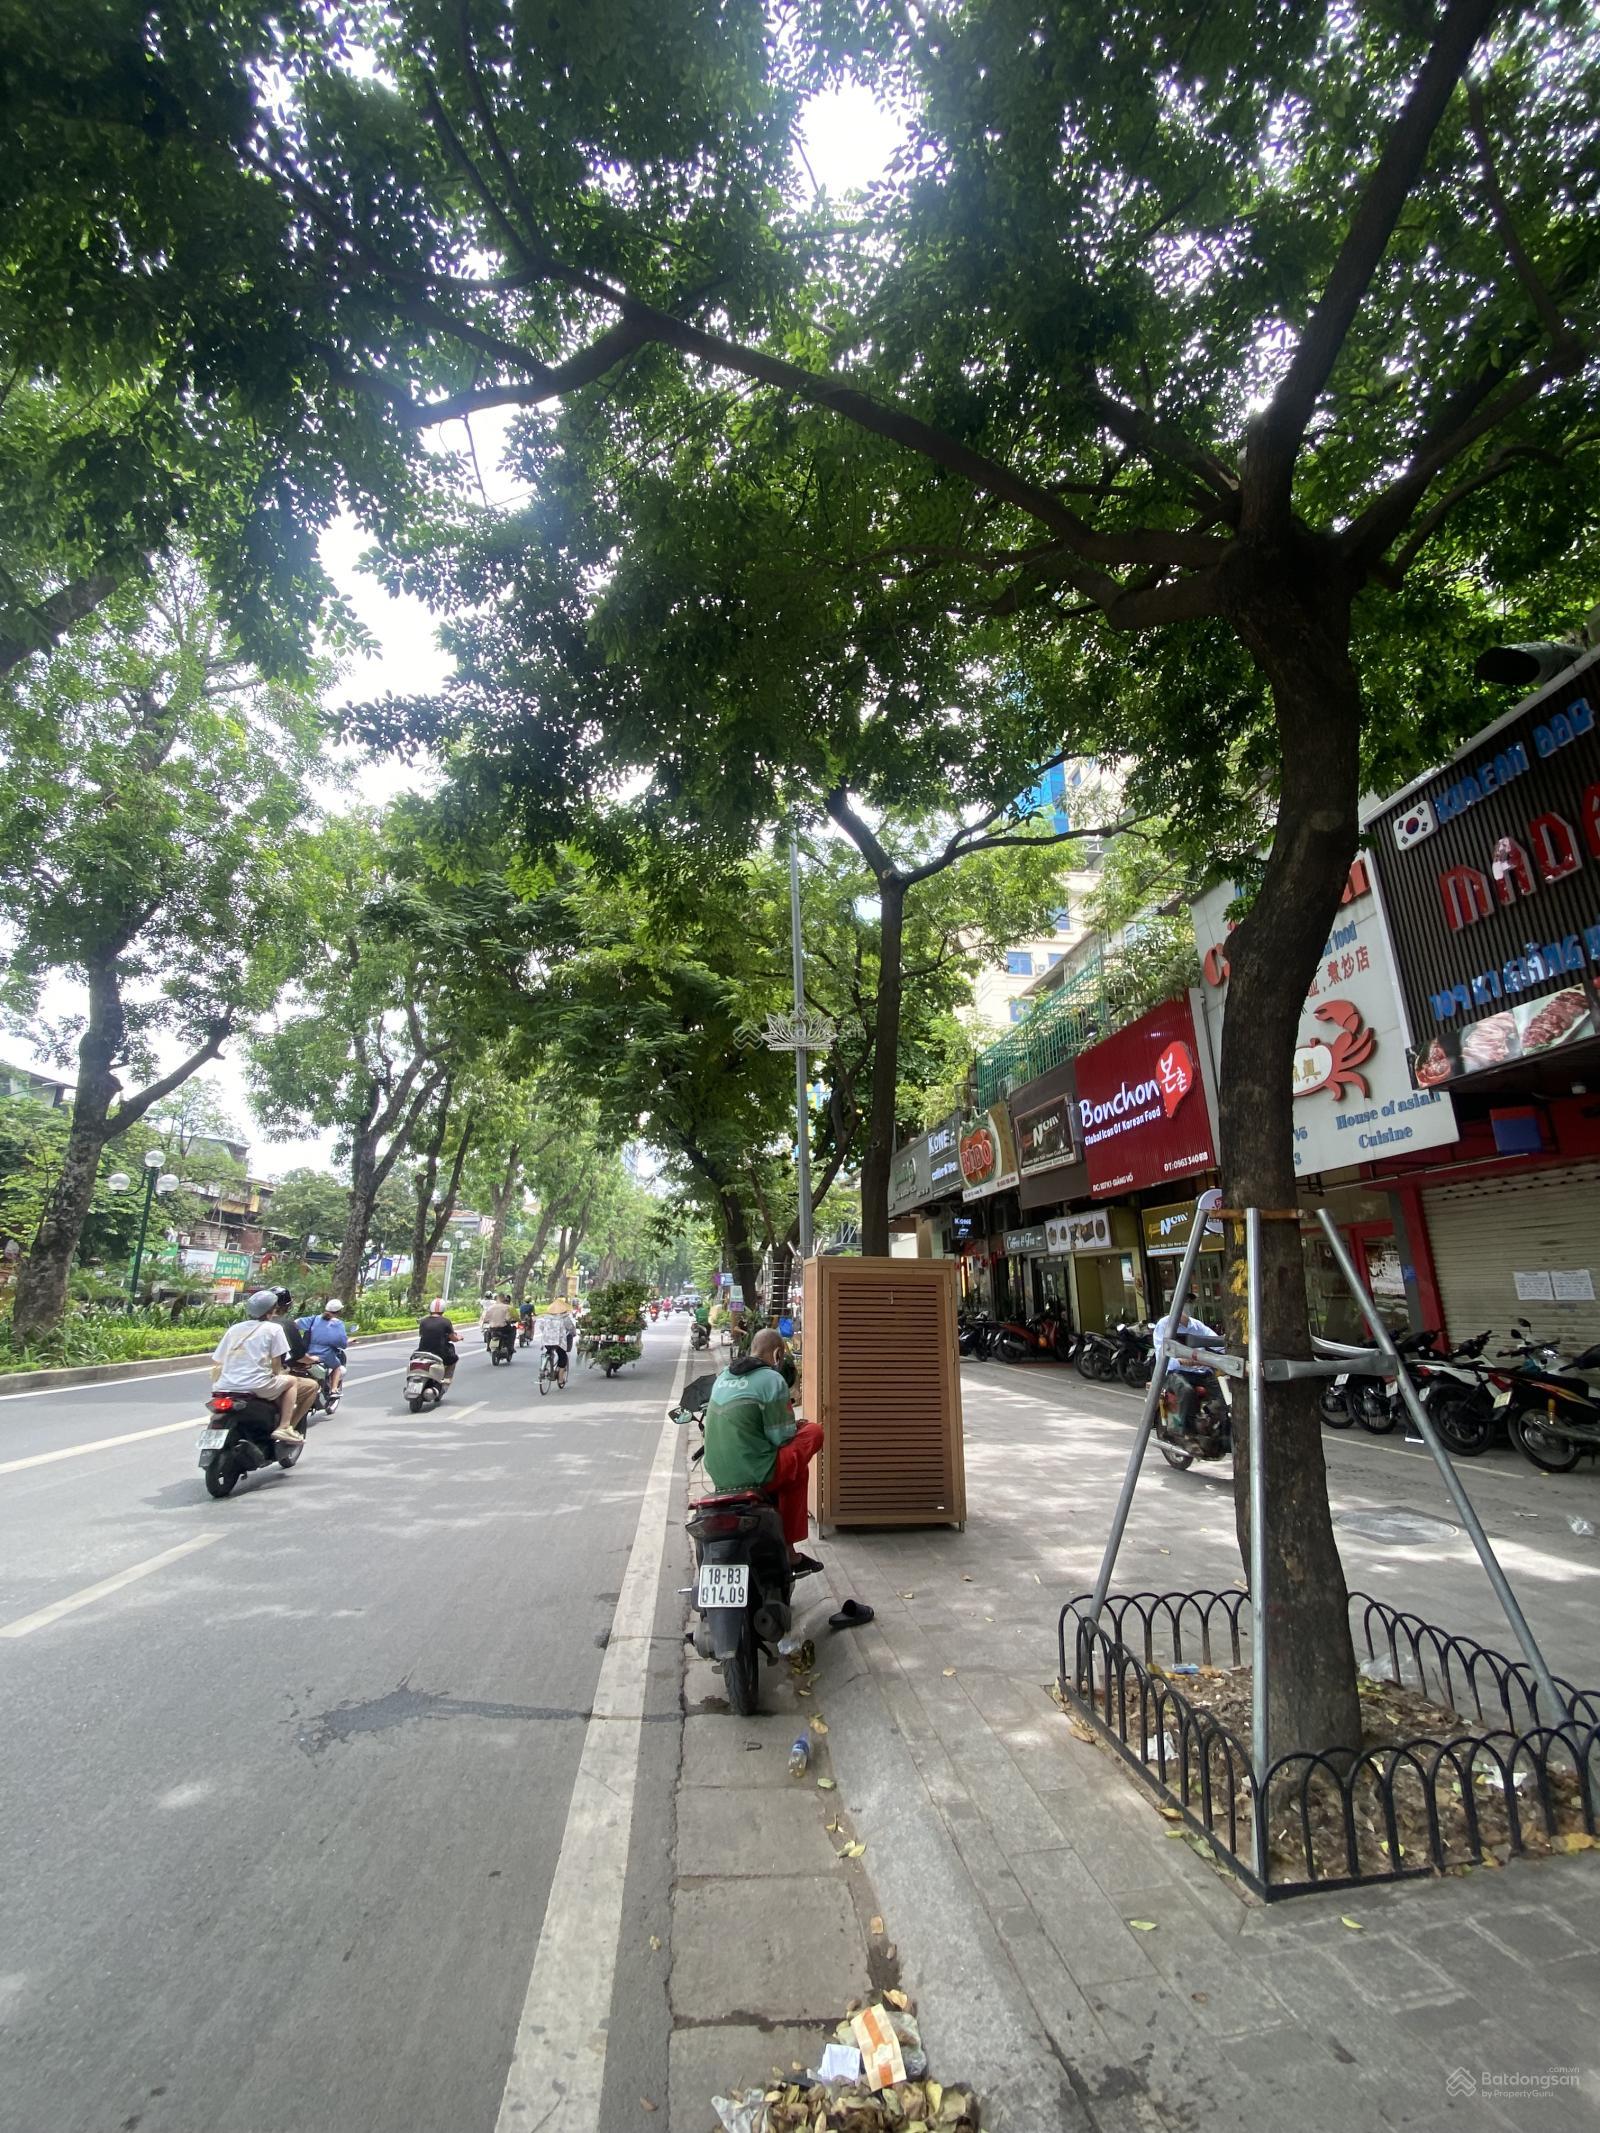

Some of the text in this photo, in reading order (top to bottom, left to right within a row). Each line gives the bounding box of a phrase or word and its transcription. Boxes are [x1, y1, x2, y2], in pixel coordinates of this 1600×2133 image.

[1432, 741, 1530, 824] KOREAN
[1079, 1078, 1160, 1128] Bonchon
[1336, 1110, 1379, 1130] House
[1381, 1100, 1396, 1117] of
[1084, 1131, 1102, 1146] Global
[1121, 1114, 1144, 1131] Korean
[1144, 1105, 1161, 1122] Food
[1359, 1126, 1413, 1149] Cuisine
[708, 1567, 741, 1585] 18-B3
